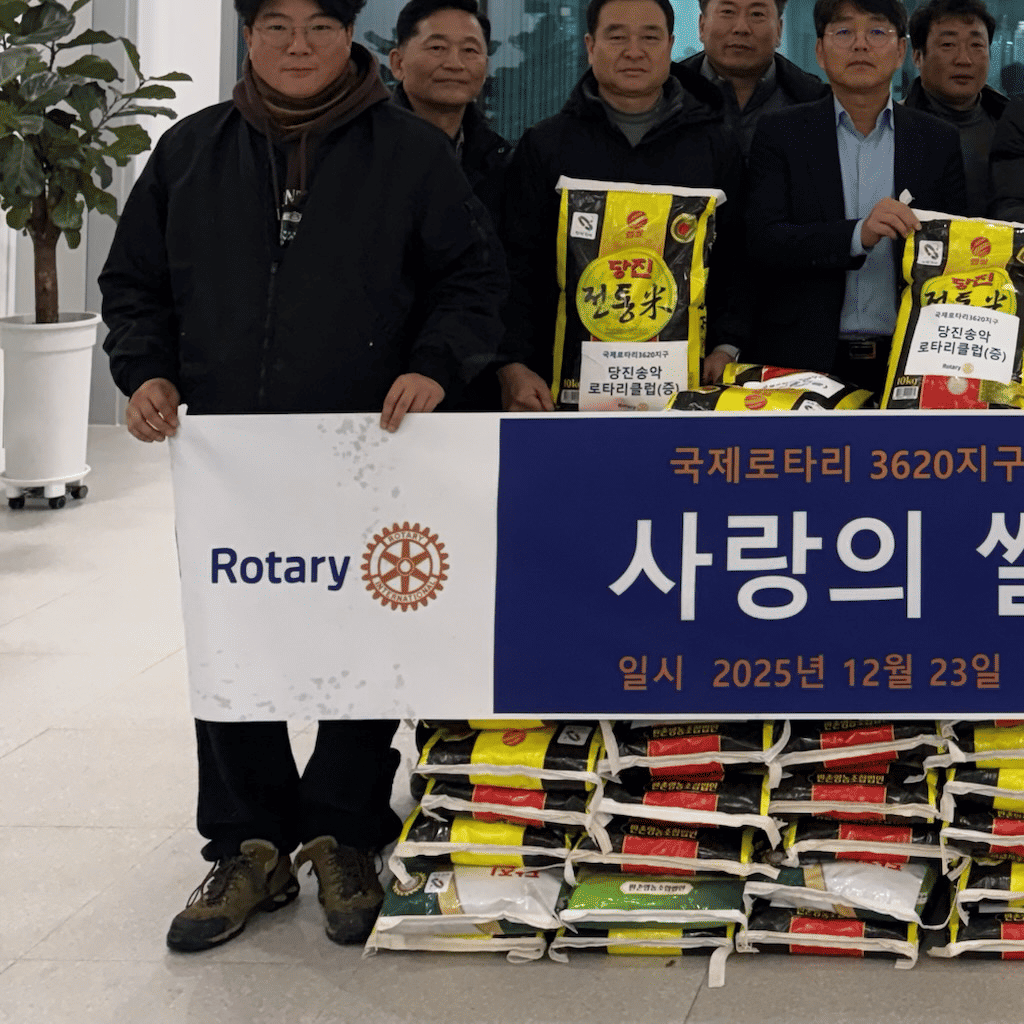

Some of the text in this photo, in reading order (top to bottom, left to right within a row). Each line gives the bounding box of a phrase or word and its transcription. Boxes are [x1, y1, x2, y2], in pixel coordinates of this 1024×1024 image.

[608, 258, 654, 280] 당진
[951, 273, 995, 290] 당진
[935, 310, 998, 324] 국제로타리3620지구
[937, 325, 992, 343] 당진송악
[602, 350, 669, 360] 국제로타리3620지구
[917, 340, 1008, 363] 로타리클럽(증)
[608, 366, 663, 381] 당진송악
[942, 363, 961, 372] Rotary
[588, 381, 679, 397] 로타리클럽(증)
[670, 444, 851, 483] 국제로타리
[388, 532, 425, 543] ROTARY
[211, 547, 351, 591] Rotary
[608, 510, 922, 621] 사랑의
[375, 580, 436, 602] INTERNATIONAL
[618, 655, 683, 691] 일시
[712, 655, 824, 690] 2025년
[843, 654, 912, 690] 12월
[929, 654, 1000, 689] 23일
